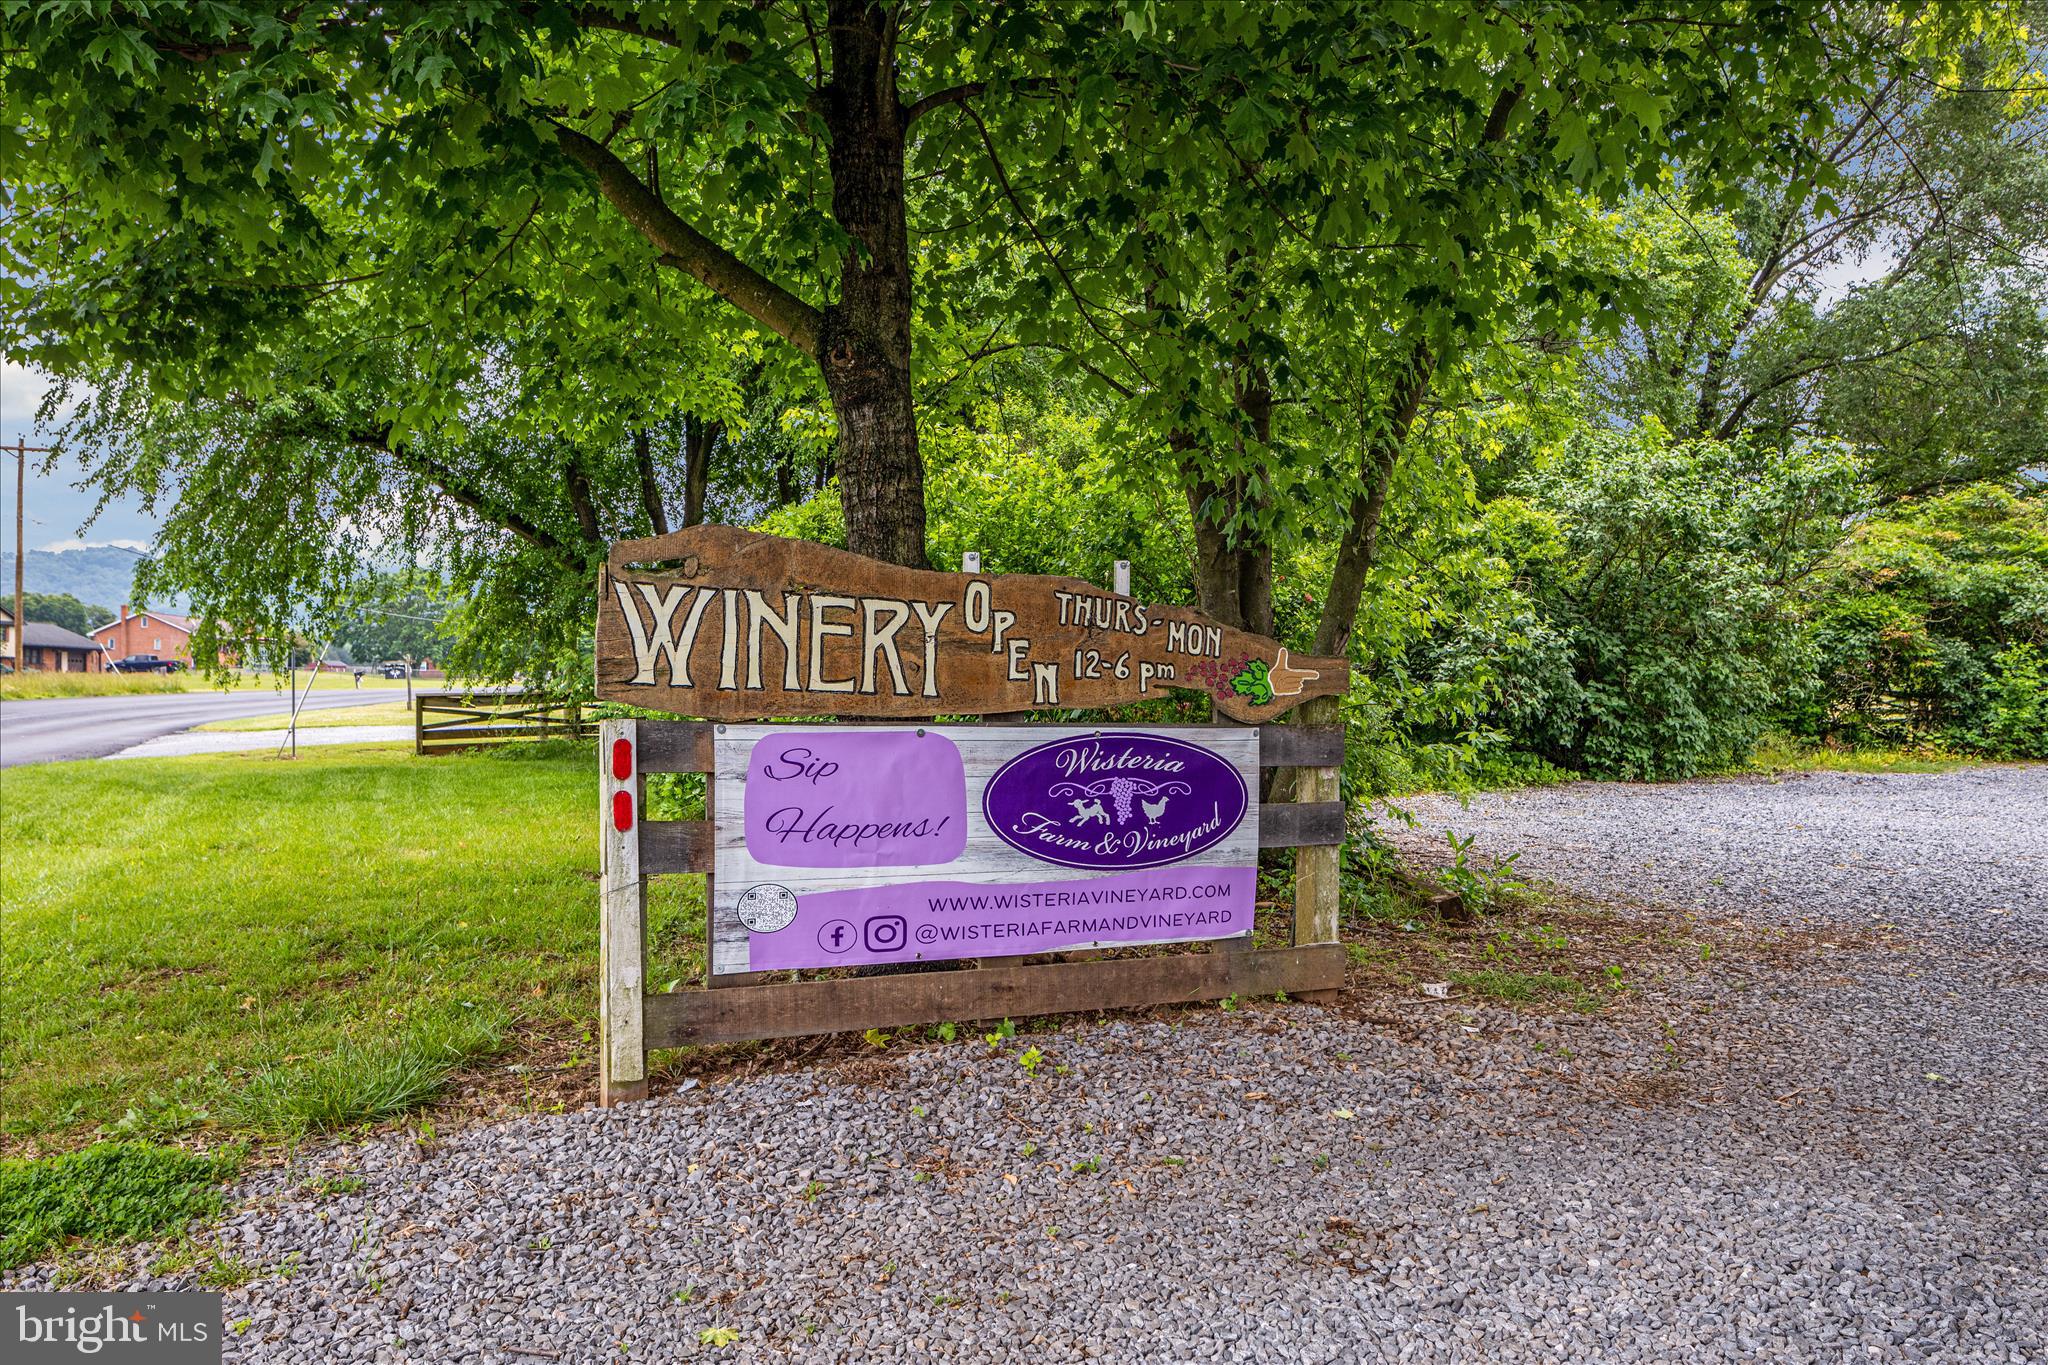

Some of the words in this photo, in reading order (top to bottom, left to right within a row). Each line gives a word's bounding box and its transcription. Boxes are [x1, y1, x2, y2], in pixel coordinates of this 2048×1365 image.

[613, 578, 953, 697] WINERY
[965, 580, 1059, 704] OPEN
[1074, 649, 1130, 680] 12-6
[1139, 661, 1175, 693] pm
[764, 748, 839, 785] Sip
[1056, 742, 1185, 777] Wisteria
[765, 805, 950, 847] Happens!
[1012, 812, 1091, 851] Farm
[1094, 831, 1121, 855] &
[1123, 801, 1222, 858] Vineyard
[928, 884, 1231, 913] WWW.WISTERIAVINEYARD.COM
[915, 910, 1232, 945] @WISTERIAFARMANDVINEYARD
